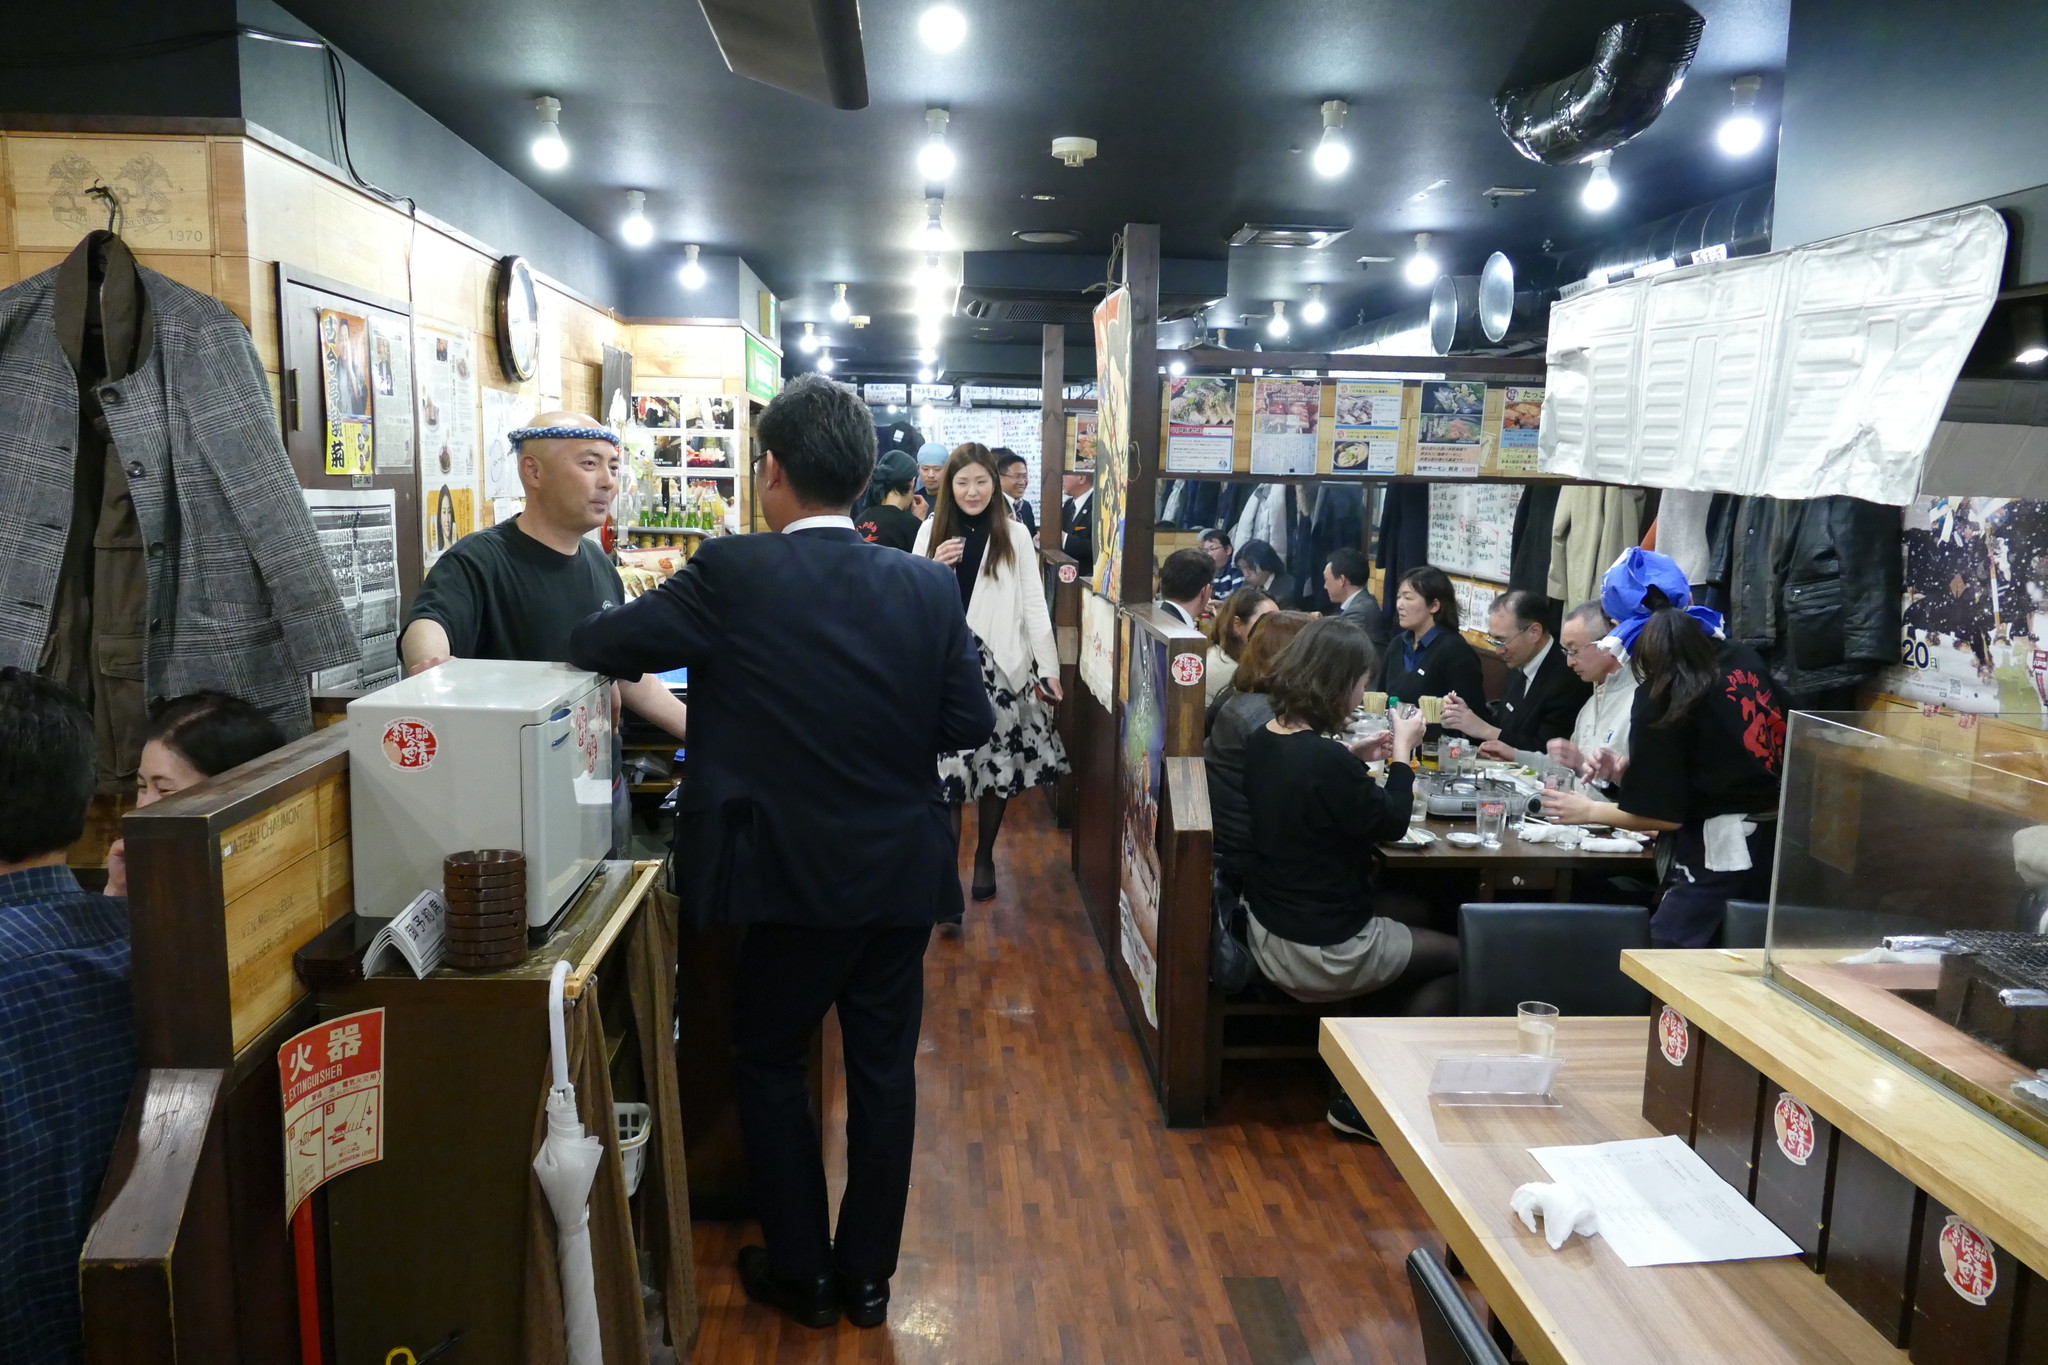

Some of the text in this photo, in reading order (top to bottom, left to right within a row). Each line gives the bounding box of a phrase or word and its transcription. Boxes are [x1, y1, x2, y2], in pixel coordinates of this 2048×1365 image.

[168, 230, 203, 242] 1970
[279, 1023, 363, 1082] 火器
[288, 1063, 343, 1103] EXTINGUISHER
